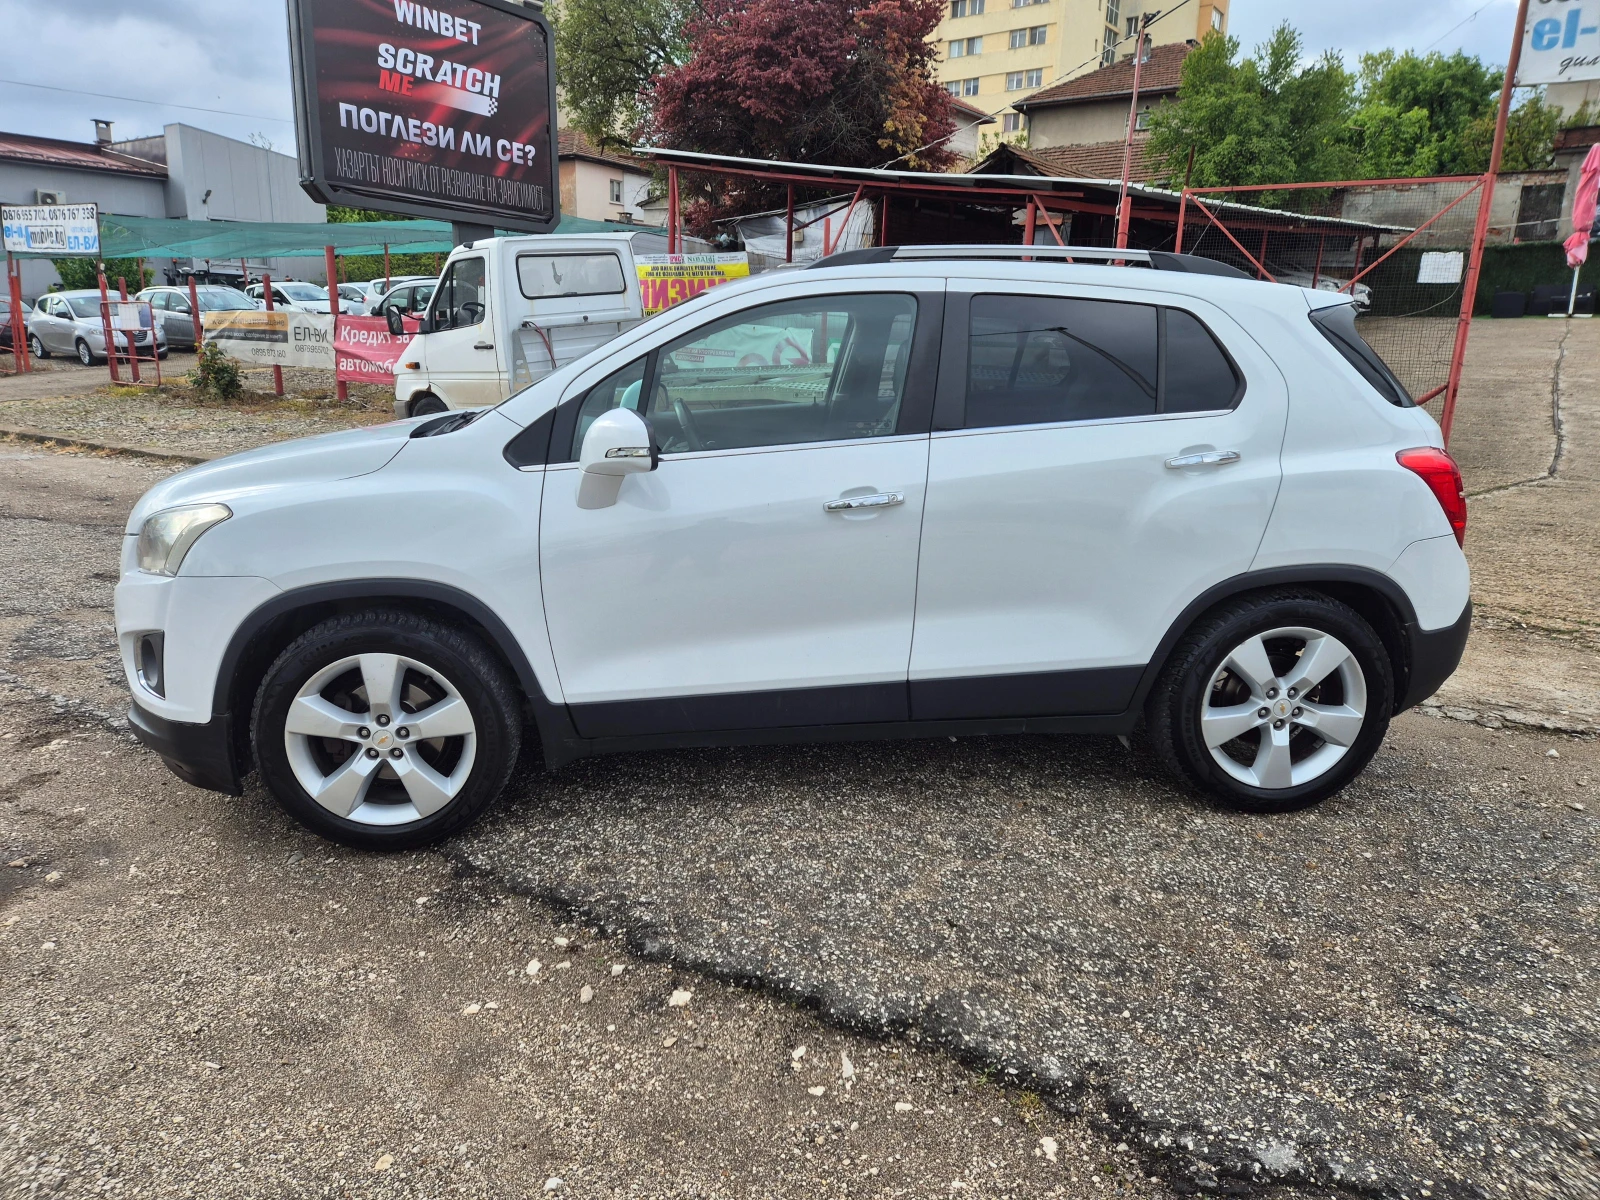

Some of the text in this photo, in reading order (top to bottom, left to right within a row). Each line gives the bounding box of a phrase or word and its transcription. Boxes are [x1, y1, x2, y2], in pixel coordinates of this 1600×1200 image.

[394, 0, 481, 46] WINBET
[377, 42, 501, 98] SCRATCH
[378, 69, 414, 97] ME
[338, 102, 536, 168] ПОГЛЕЗИ ЛИ СЕ?
[334, 147, 545, 211] ХАЗАРТЪТ НОСИ РИСК ОТ РАЗВИВАНЕ НА ЗАВИСИМОСТ
[2, 209, 21, 221] 0876
[48, 208, 66, 220] 0876
[67, 208, 80, 220] 767
[31, 228, 65, 246] mobile.bg
[293, 326, 329, 344] ЕЛ-ВИ
[340, 326, 391, 347] Кредит
